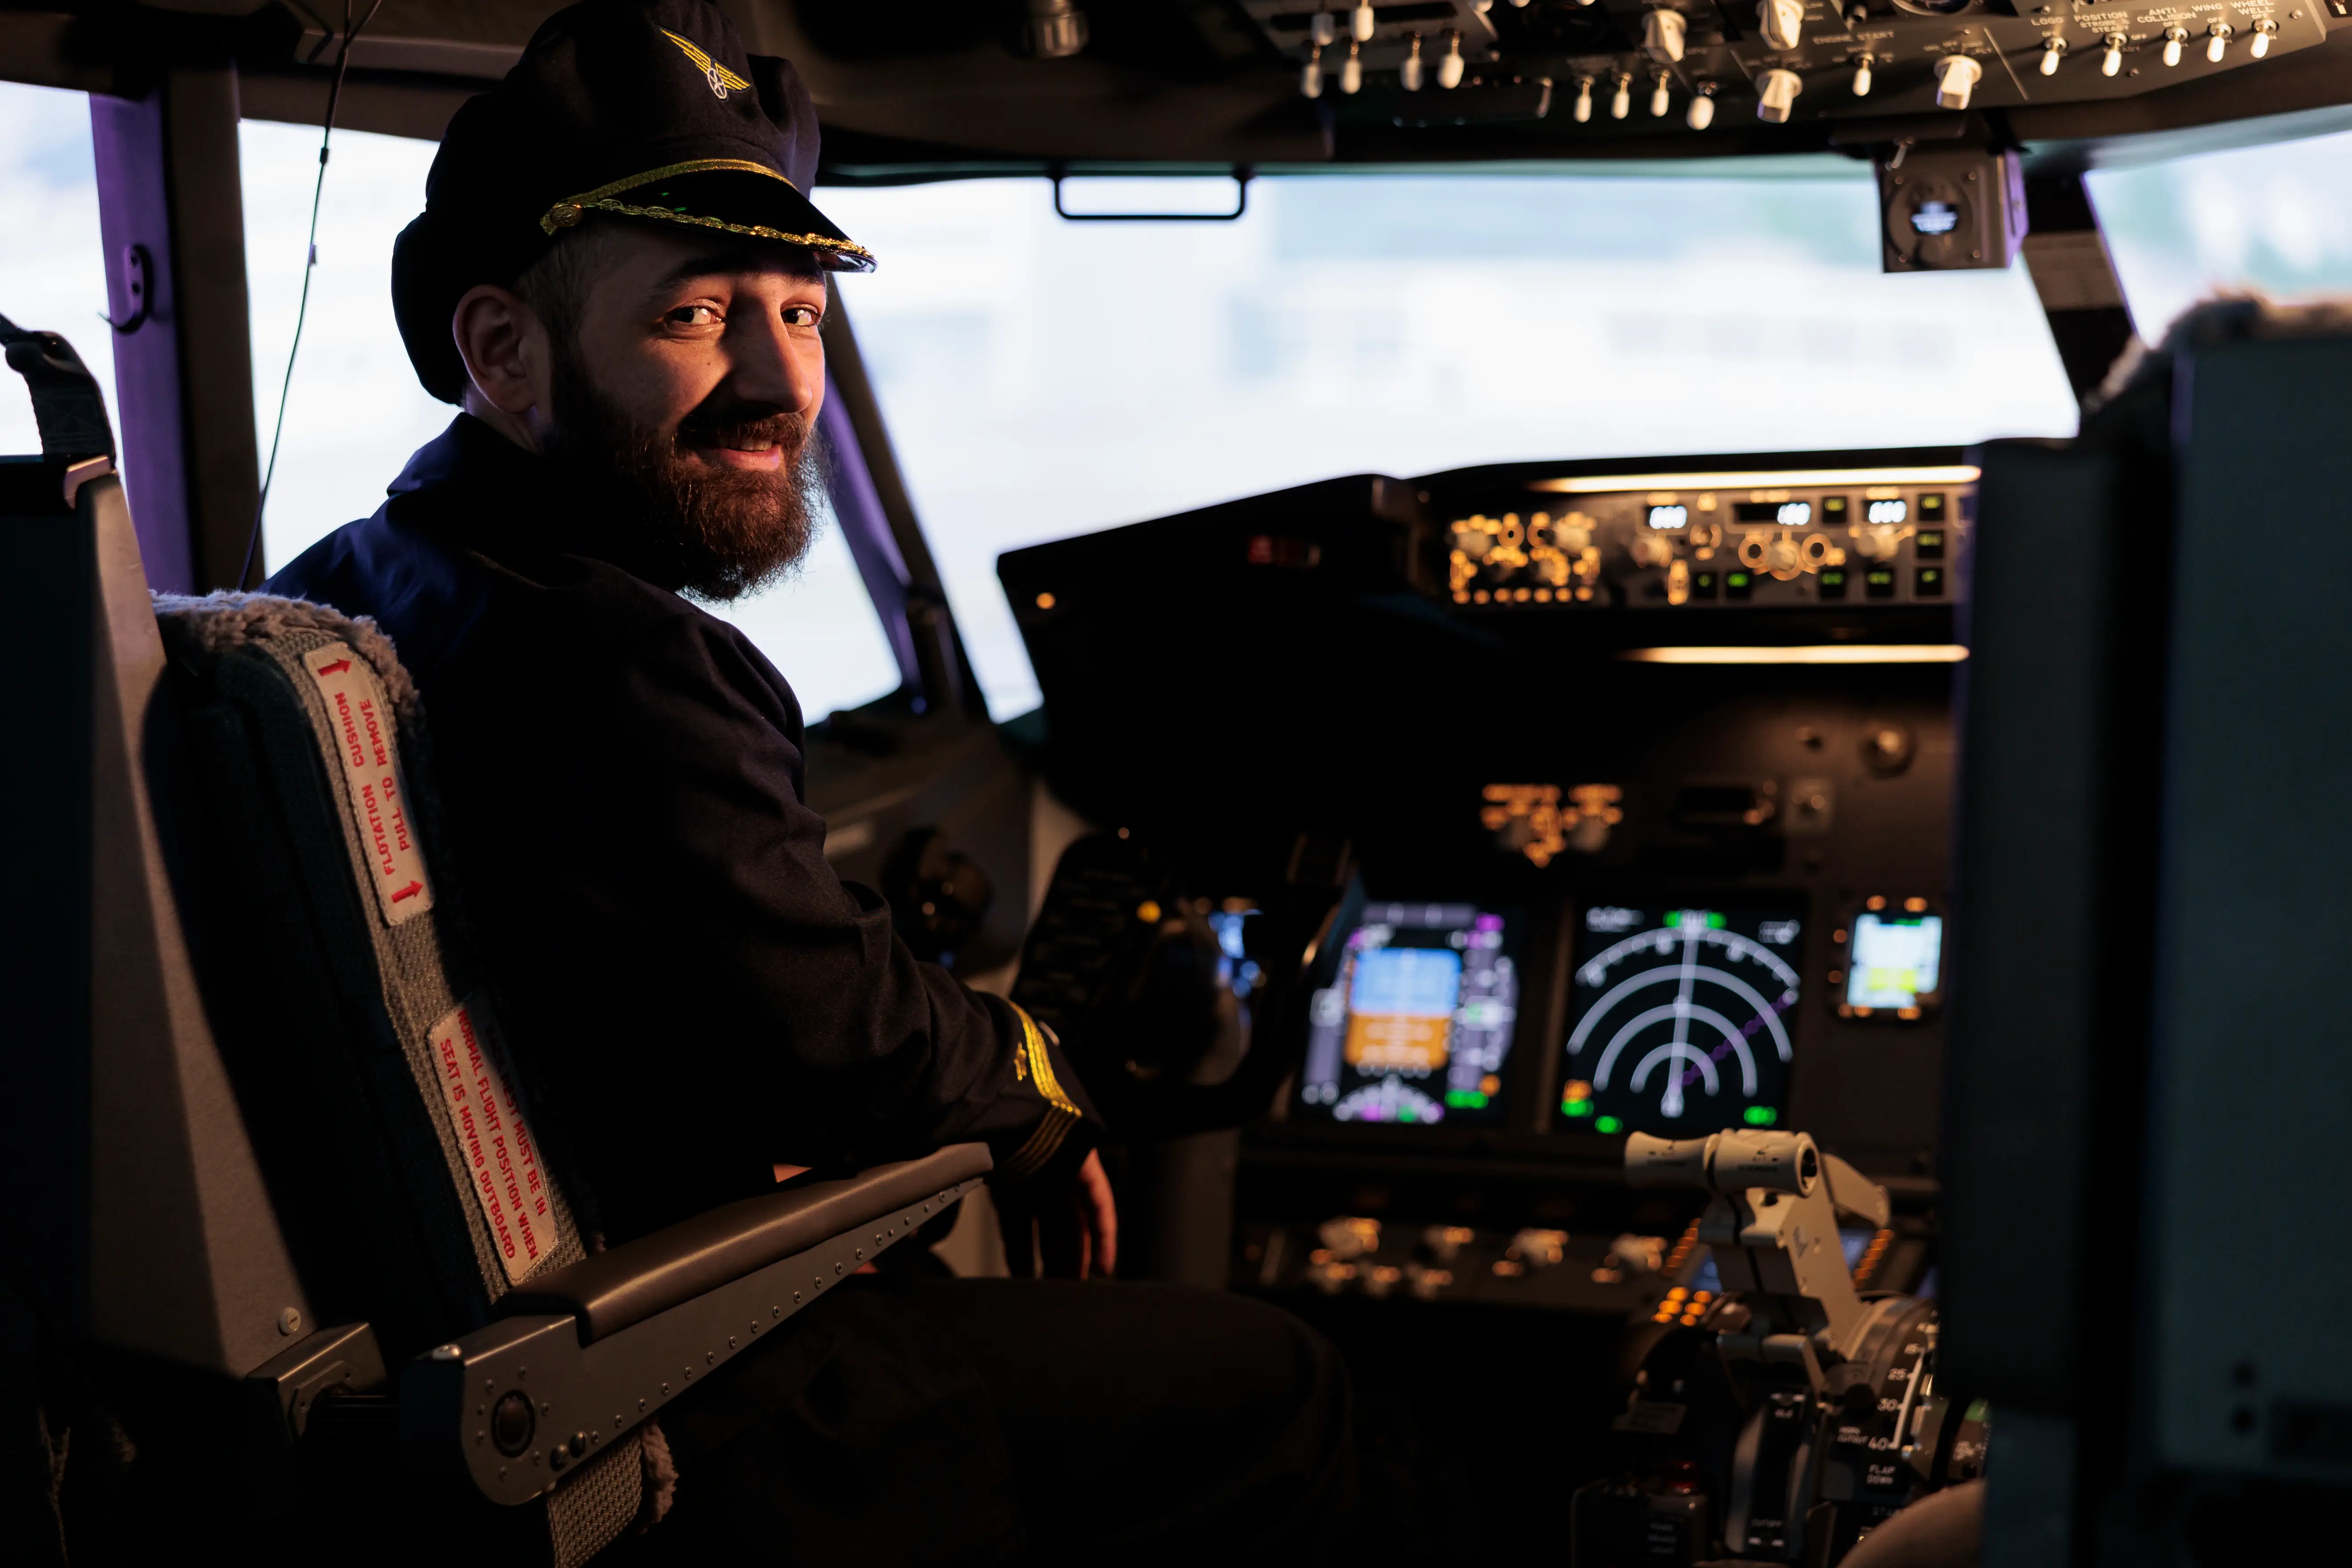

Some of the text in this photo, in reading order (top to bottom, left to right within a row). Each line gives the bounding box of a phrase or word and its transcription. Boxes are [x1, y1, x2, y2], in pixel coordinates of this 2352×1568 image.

[2149, 6, 2177, 16] ANTI
[2191, 3, 2224, 12] WING
[2230, 0, 2275, 9] WHEEL
[2238, 6, 2275, 16] WELL
[2031, 16, 2064, 26] LOGO
[2073, 11, 2129, 23] POSITION
[2137, 12, 2197, 23] COLLISION
[2092, 25, 2130, 33] STEADY
[1812, 30, 1894, 45] ENGINE START
[359, 698, 410, 851] PULL TO REMOVE
[335, 692, 395, 875] FLOTATION CUSHION
[458, 1008, 538, 1260] NORMAL FLIGHT POSITION WHEN
[440, 1038, 515, 1258] SEAT IS MOVING OUTBOARD
[514, 1119, 534, 1165] MUST
[527, 1167, 541, 1194] BE
[535, 1195, 547, 1216] IN
[1877, 1397, 1898, 1412] 30
[1868, 1436, 1889, 1451] 40
